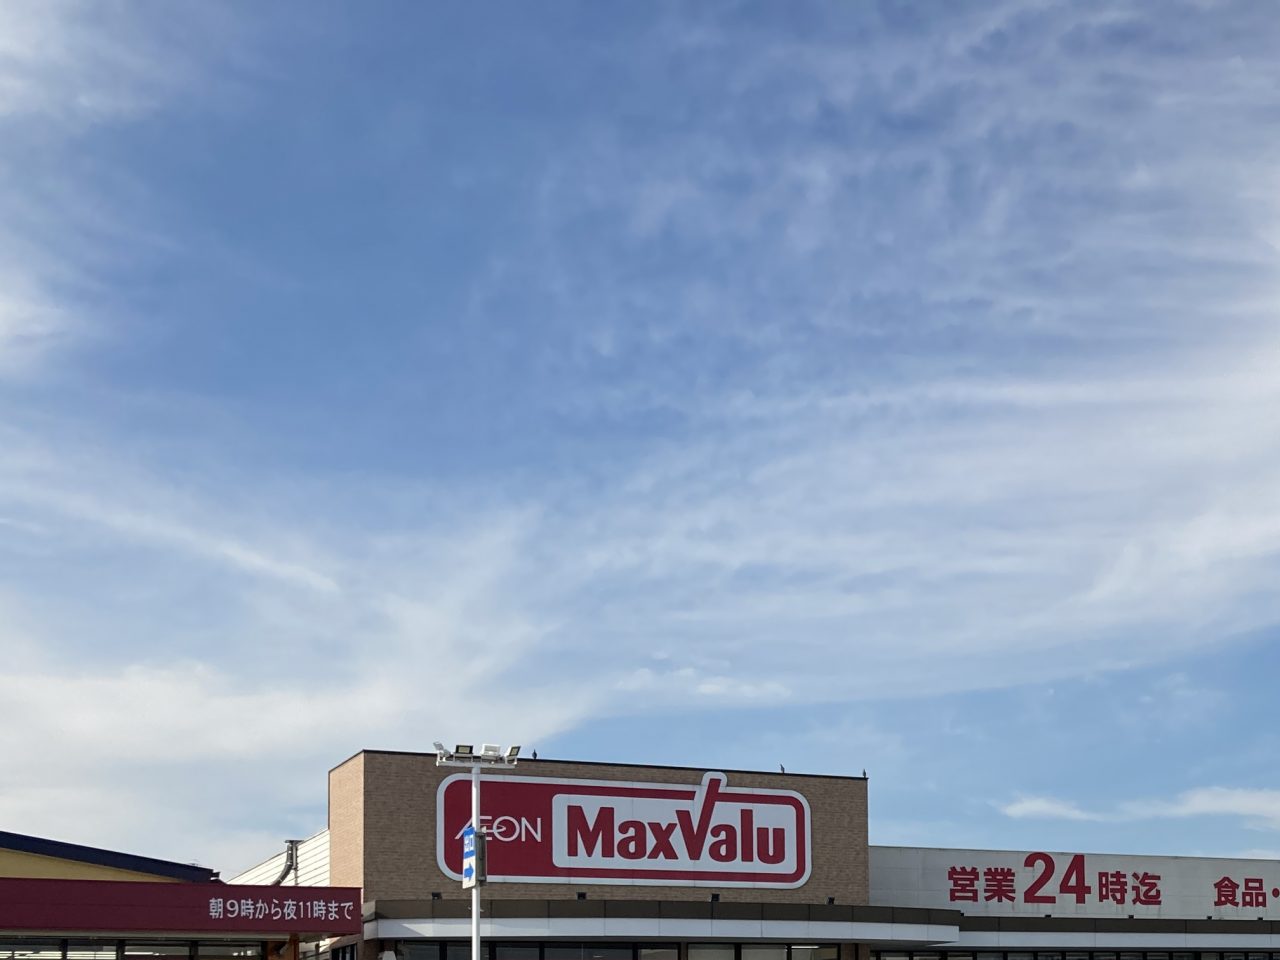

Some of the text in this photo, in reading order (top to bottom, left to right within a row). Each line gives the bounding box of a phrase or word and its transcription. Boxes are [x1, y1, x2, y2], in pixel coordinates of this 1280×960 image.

[567, 779, 785, 864] MaxValu
[947, 852, 1162, 907] 営業24時迄
[209, 898, 354, 920] 朝9時から夜11時まで
